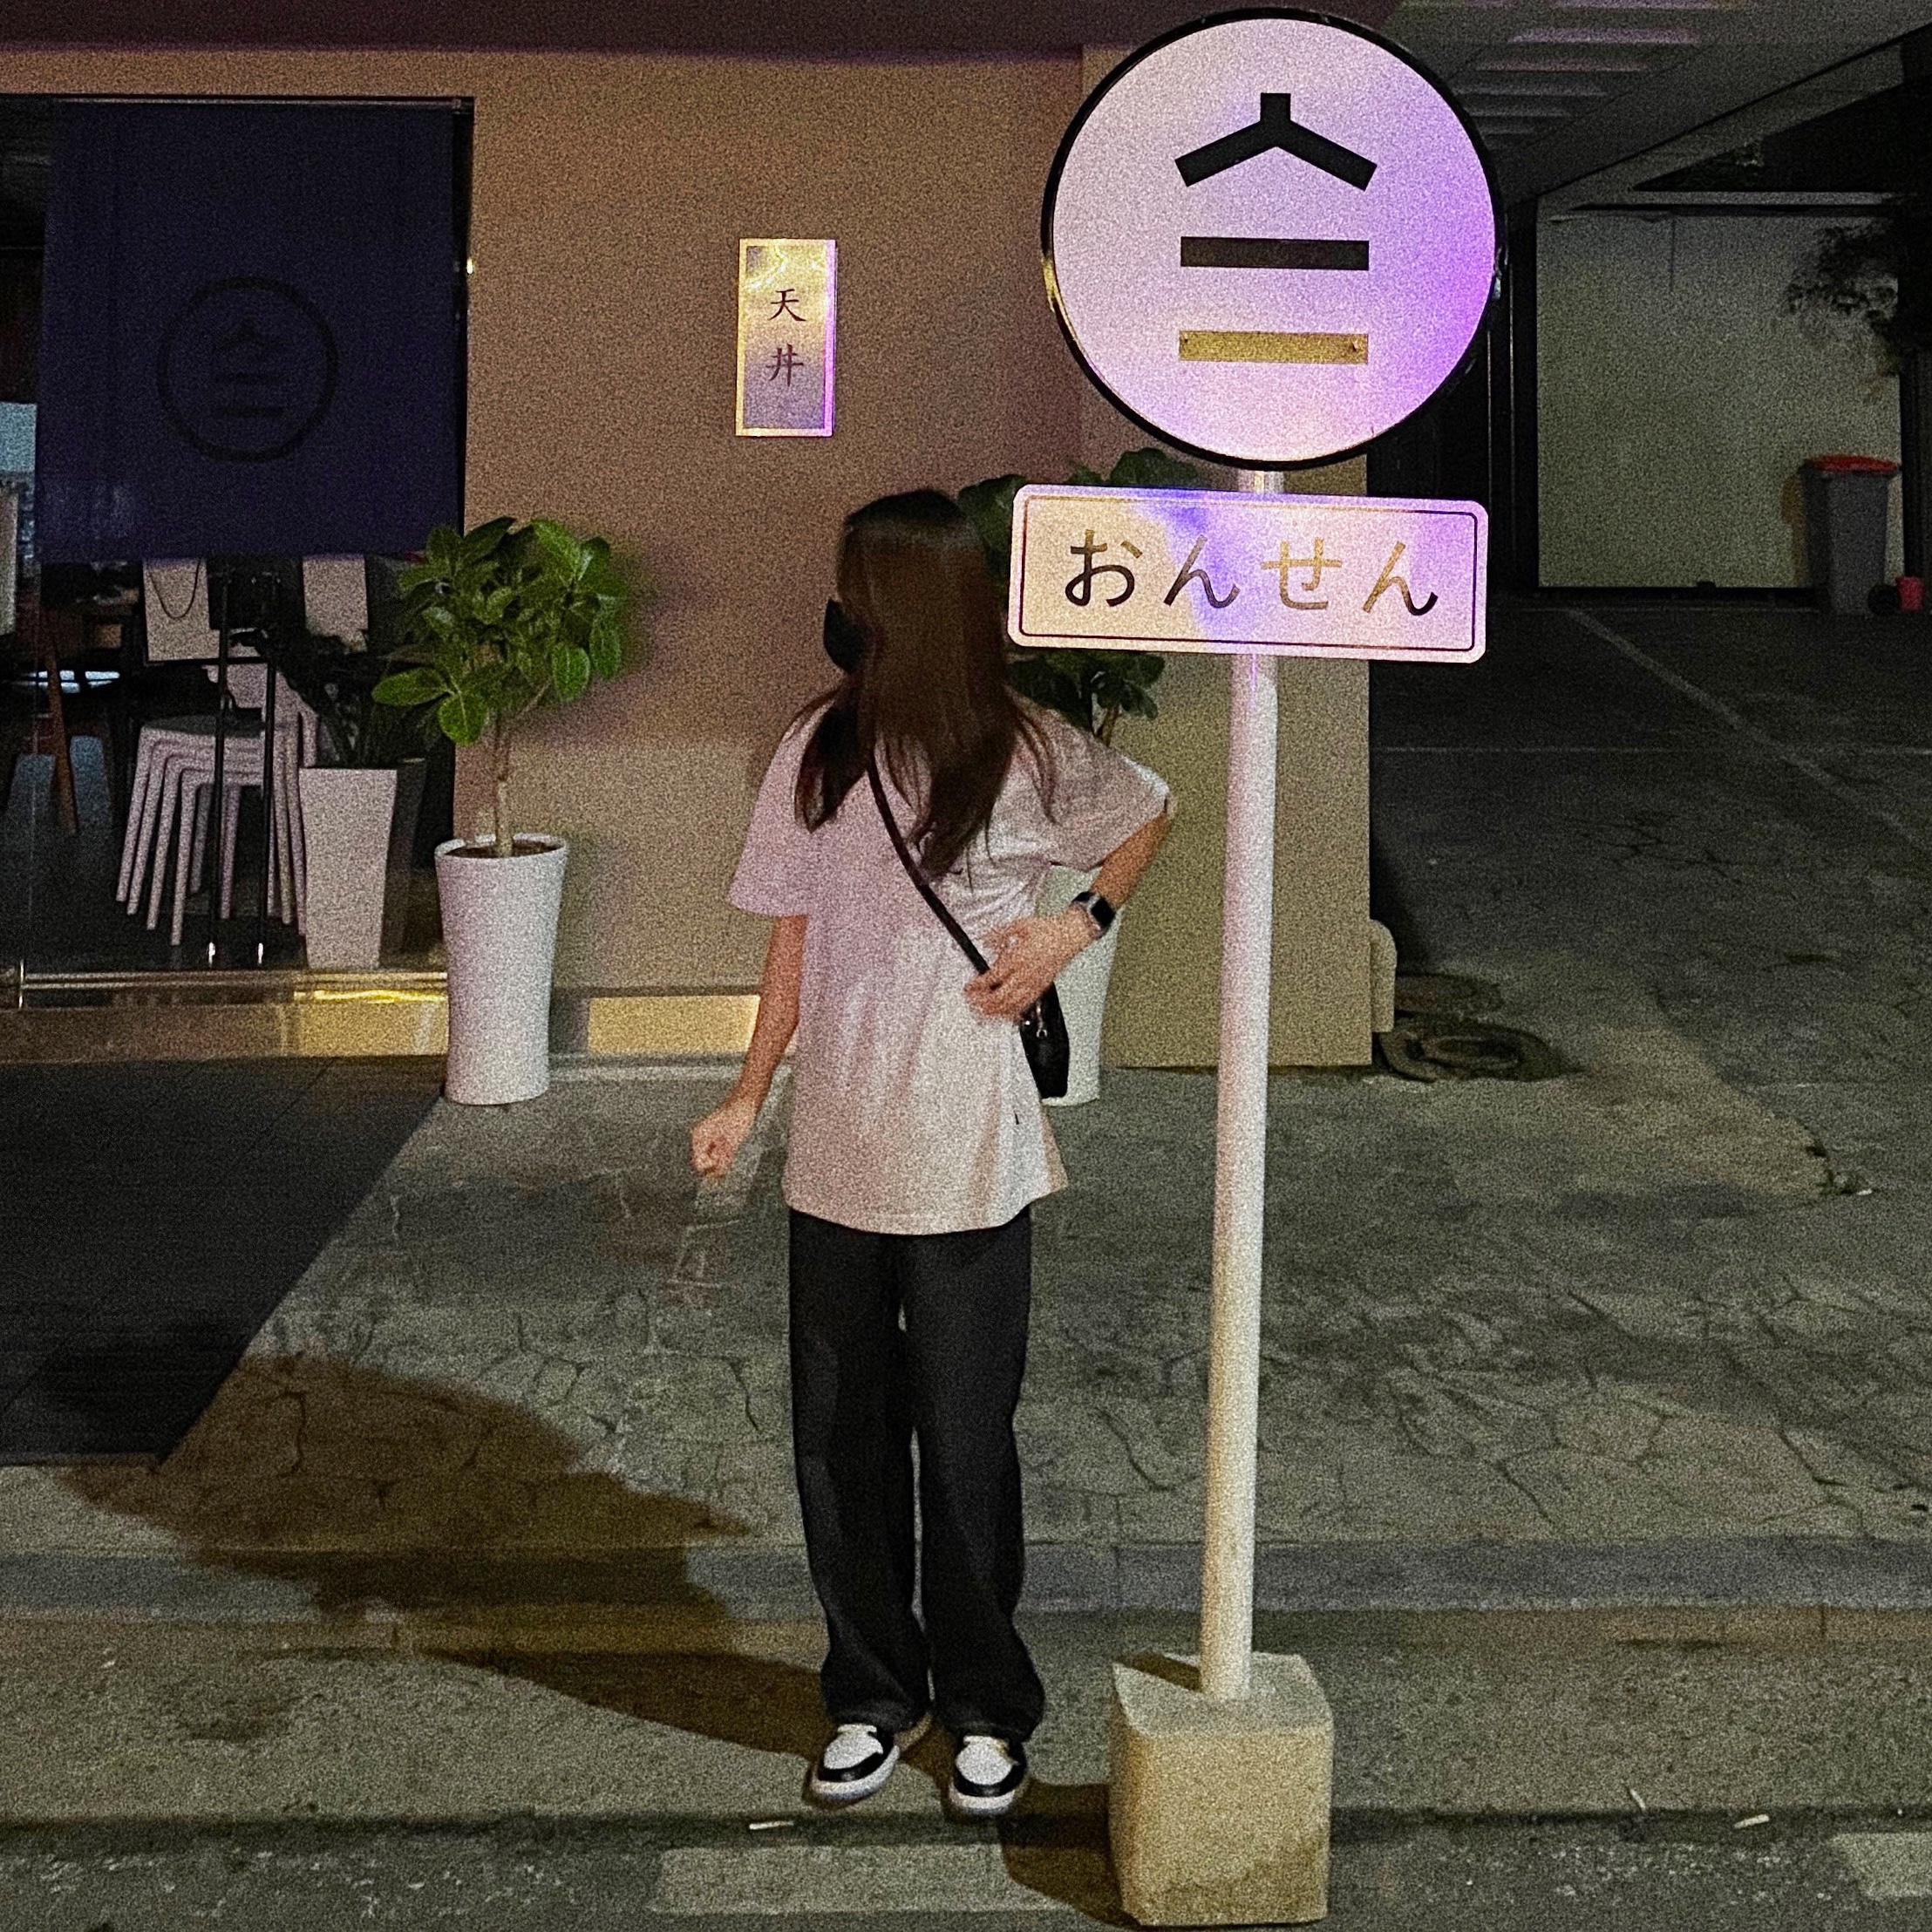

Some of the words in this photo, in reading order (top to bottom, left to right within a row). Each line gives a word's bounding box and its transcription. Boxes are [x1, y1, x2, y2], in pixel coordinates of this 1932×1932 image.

[765, 289, 806, 387] 天井
[1065, 528, 1439, 616] おんせん
